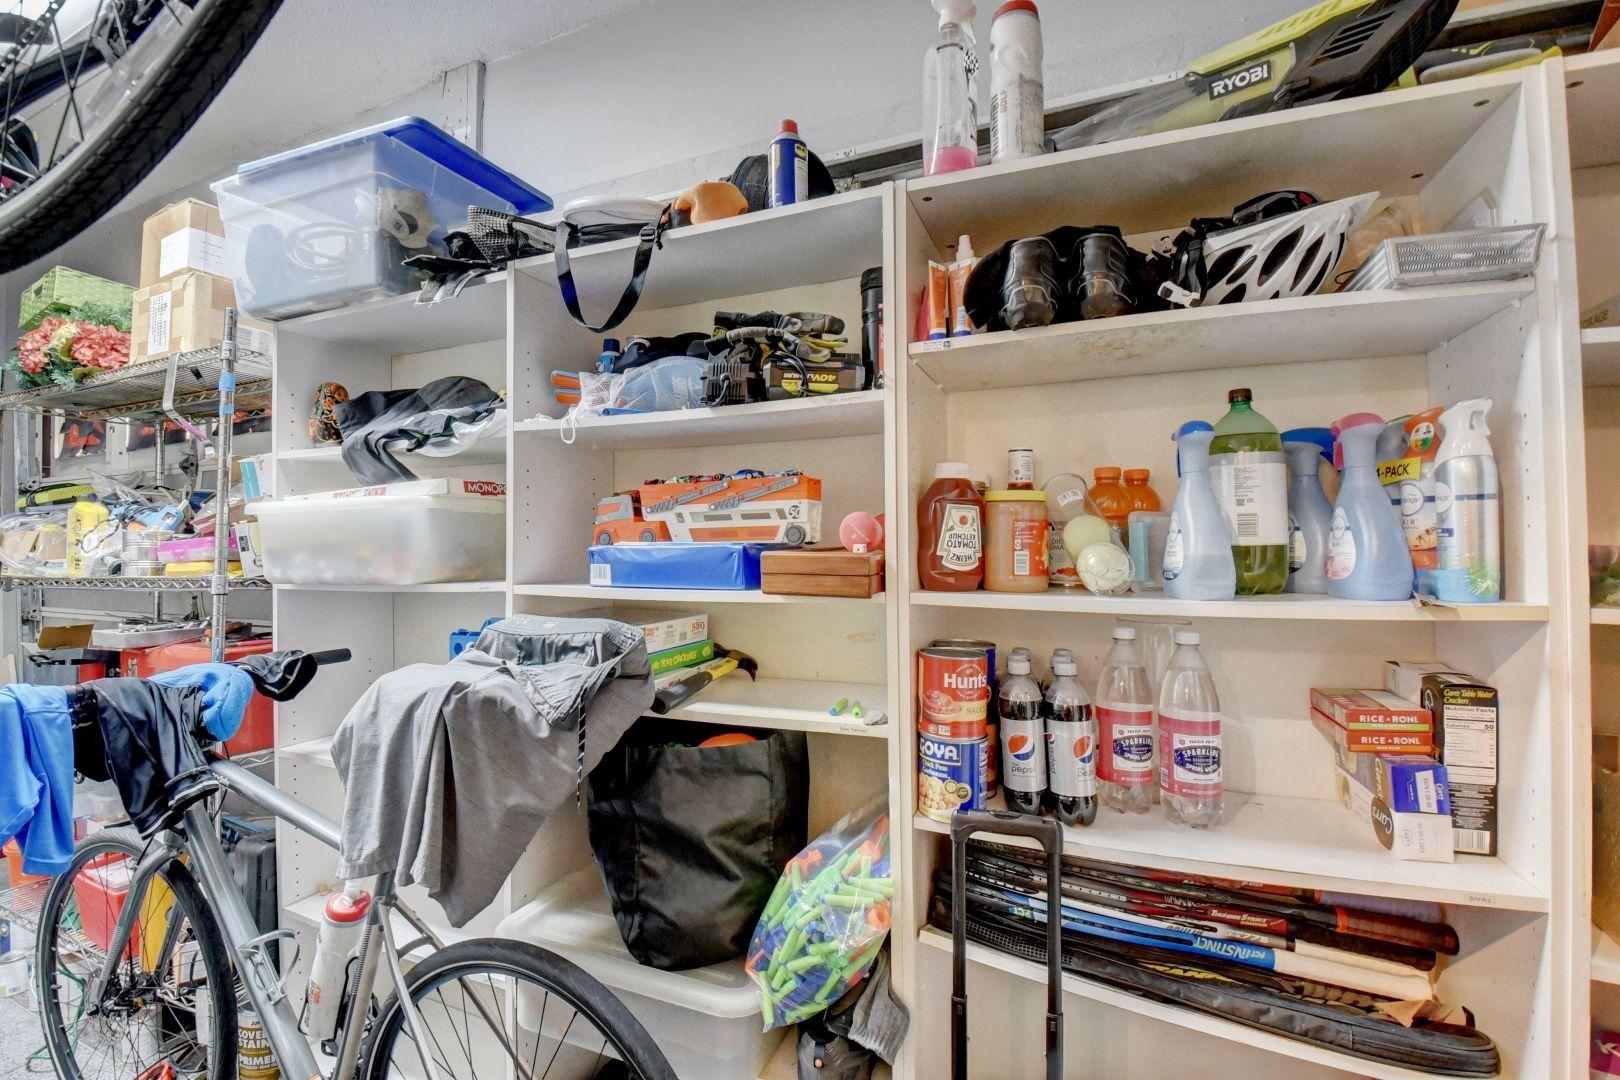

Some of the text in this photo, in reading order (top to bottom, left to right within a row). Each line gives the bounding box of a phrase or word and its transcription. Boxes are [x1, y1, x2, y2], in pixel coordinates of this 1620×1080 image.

[1211, 63, 1268, 97] RYOBI
[1580, 309, 1609, 329] TORAGE
[946, 539, 977, 549] TOMATO
[950, 552, 973, 562] HEINZ
[1359, 714, 1384, 722] RICE
[1361, 736, 1386, 744] RICE
[920, 738, 958, 761] GOYA
[1193, 936, 1250, 959] INSTINCT
[239, 1029, 265, 1039] COVE
